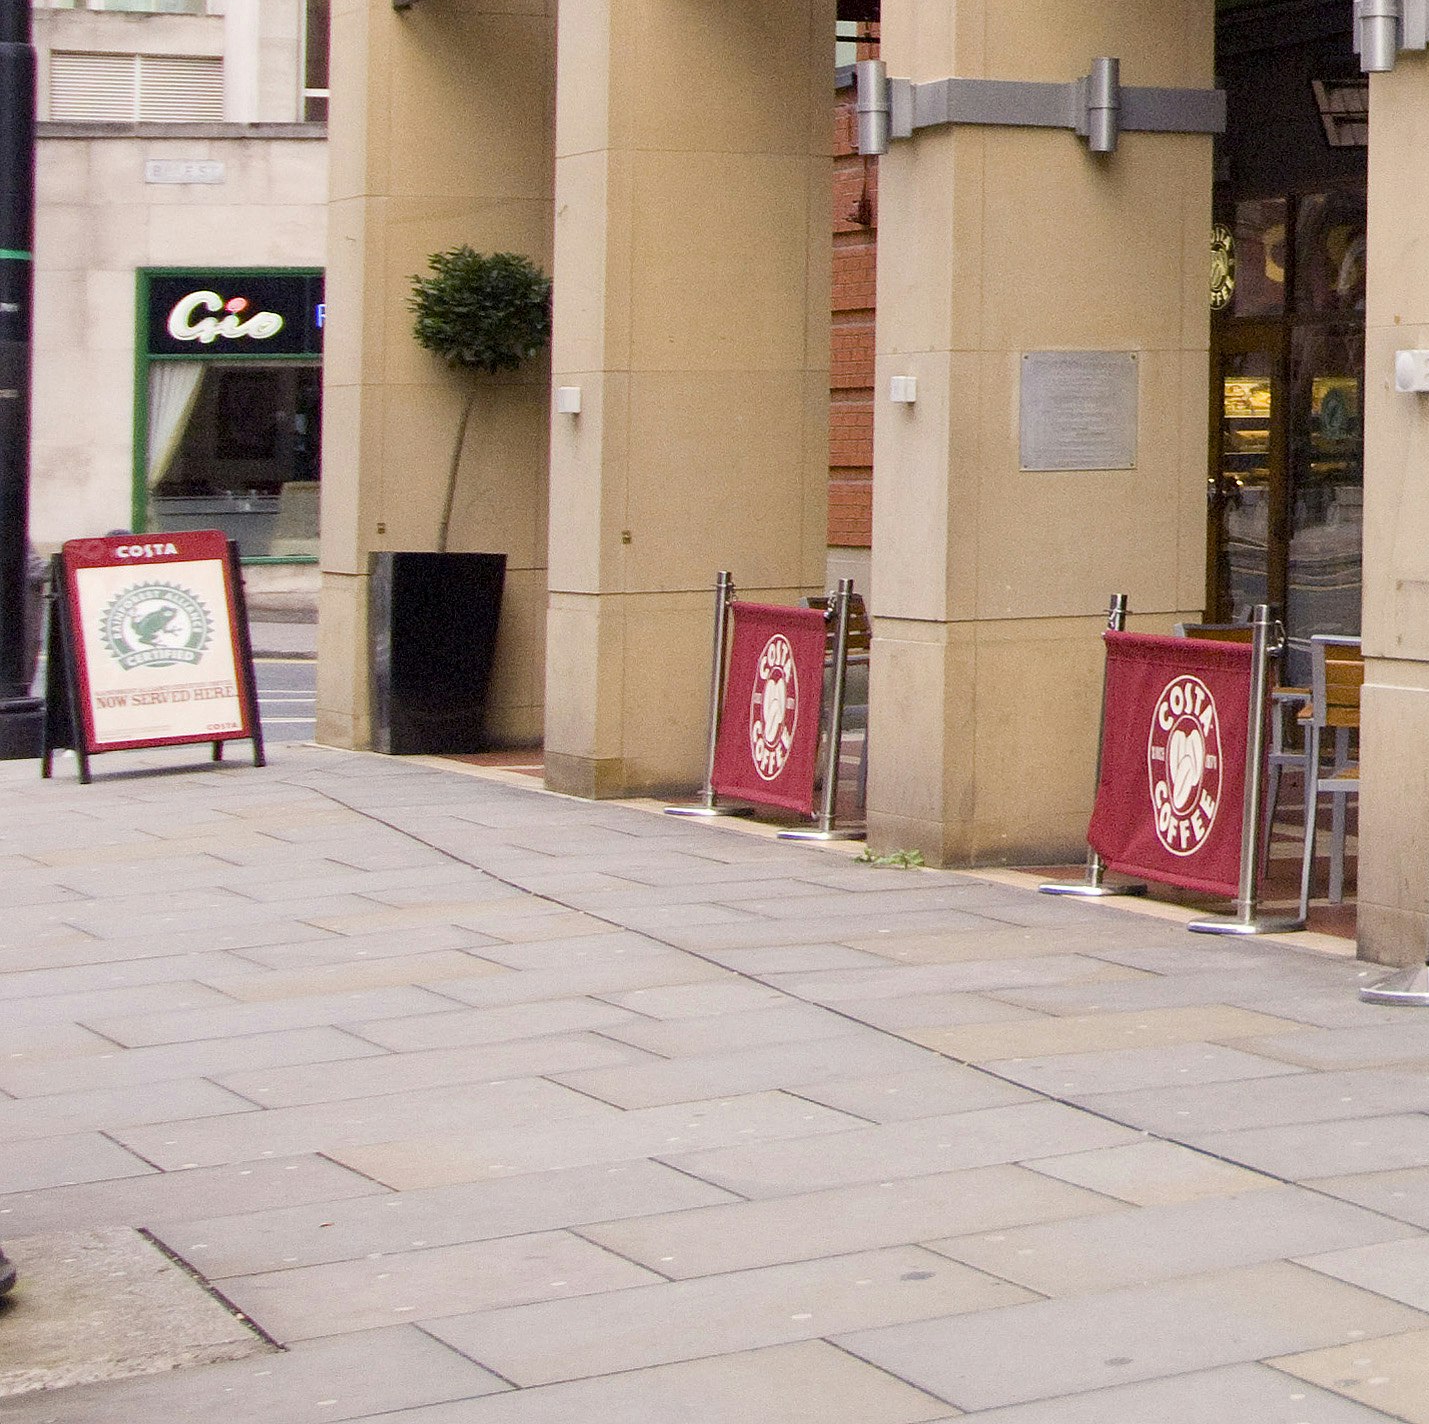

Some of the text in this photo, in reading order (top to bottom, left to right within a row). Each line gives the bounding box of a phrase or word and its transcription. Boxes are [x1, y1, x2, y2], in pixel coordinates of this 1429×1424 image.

[168, 290, 284, 344] Gio
[116, 543, 178, 558] COSTA
[760, 640, 792, 683] COSTA
[96, 695, 127, 710] NOW
[132, 689, 190, 706] SERVED
[1159, 682, 1212, 737] COSTA
[754, 720, 791, 775] COFFEE
[1155, 780, 1215, 849] COFFEE
